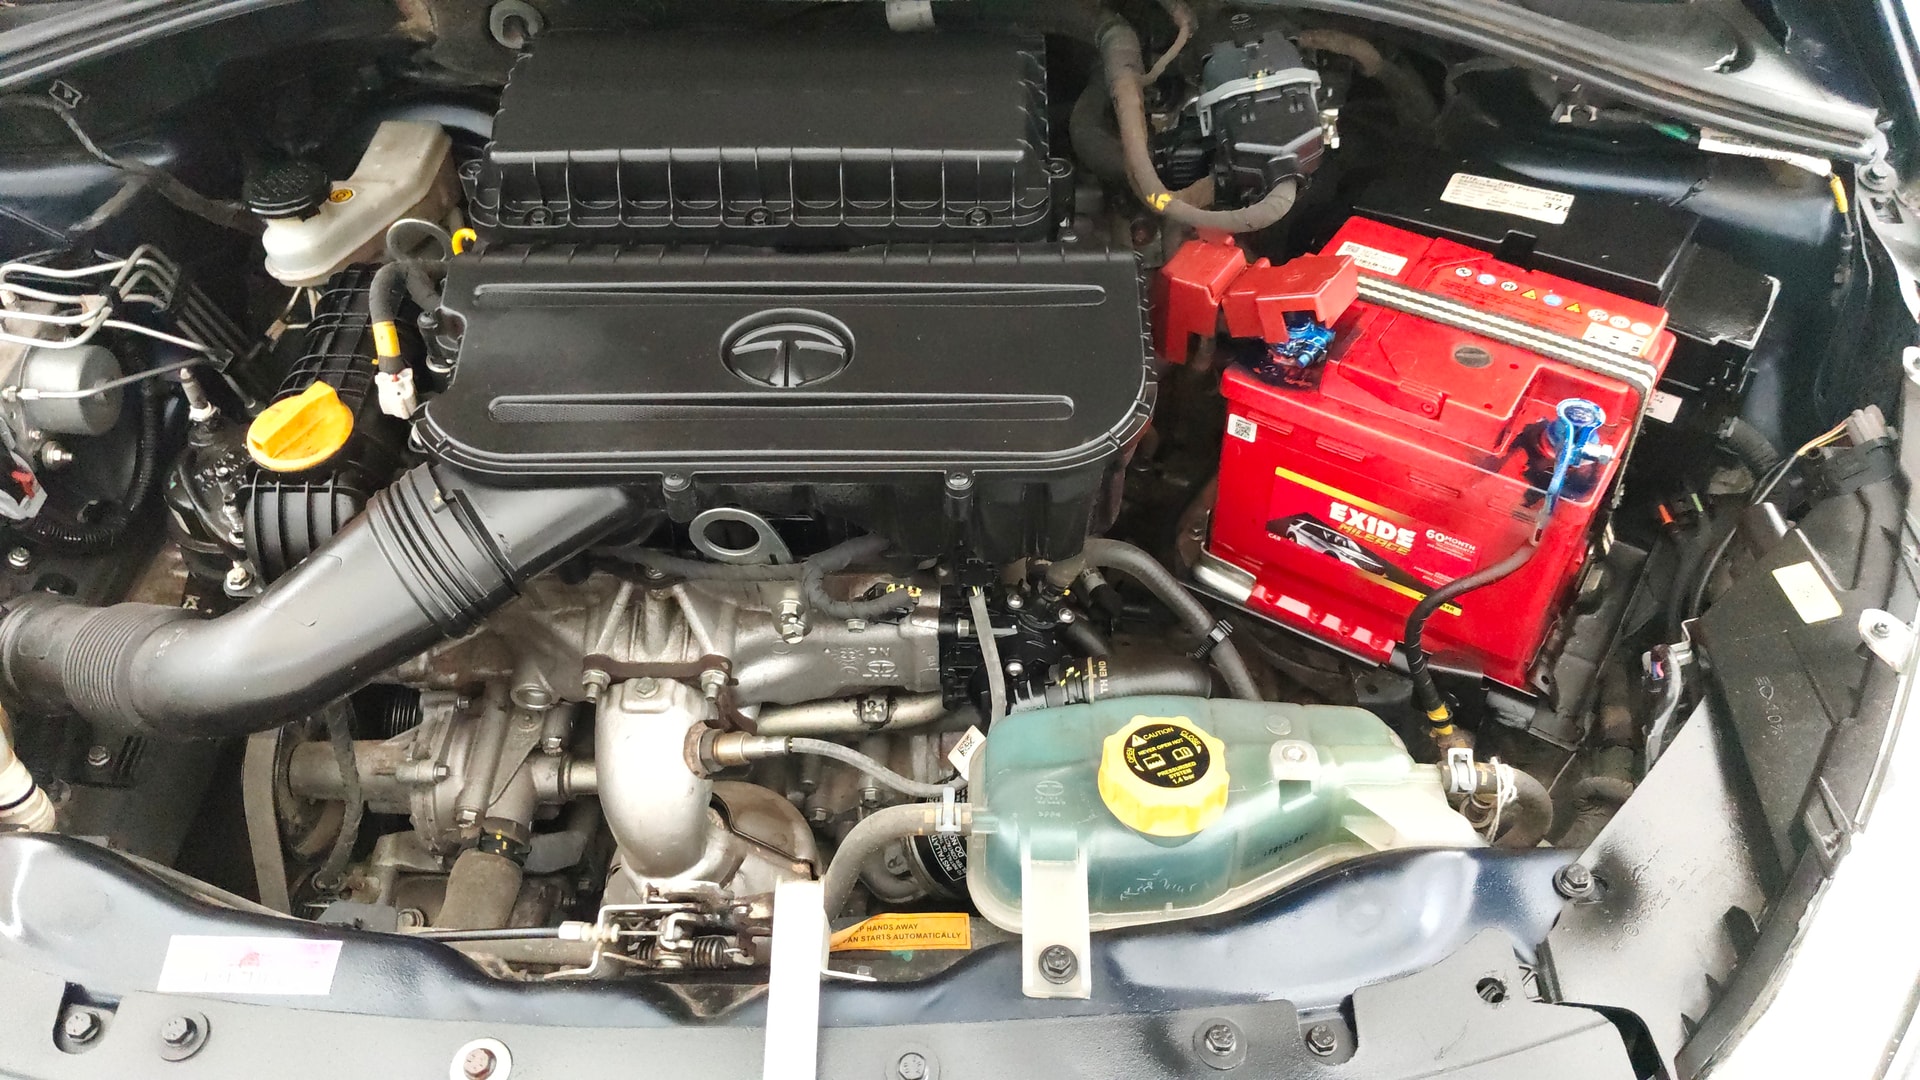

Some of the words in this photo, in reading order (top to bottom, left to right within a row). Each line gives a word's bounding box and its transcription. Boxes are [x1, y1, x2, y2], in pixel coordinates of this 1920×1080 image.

[1329, 502, 1417, 548] EXIDE
[1338, 523, 1411, 555] MILEAGE
[1426, 529, 1445, 543] 60
[1445, 535, 1476, 551] MONTH
[1098, 660, 1108, 677] END
[1100, 679, 1109, 694] TH
[1143, 727, 1174, 740] CAUTION
[1180, 730, 1201, 747] CLOSE
[1126, 747, 1135, 763] OPEN
[1138, 747, 1157, 755] NEVER
[1156, 741, 1173, 750] OPEN
[1168, 768, 1193, 779] SYSTEM
[1172, 776, 1183, 784] 1.4
[1182, 773, 1195, 781] bar
[949, 834, 959, 846] NO
[930, 834, 953, 872] INSTALLATI
[953, 846, 965, 858] DO
[866, 924, 893, 932] HANDS
[861, 933, 891, 942] STARTS
[893, 932, 961, 940] AUTOMATICALLY
